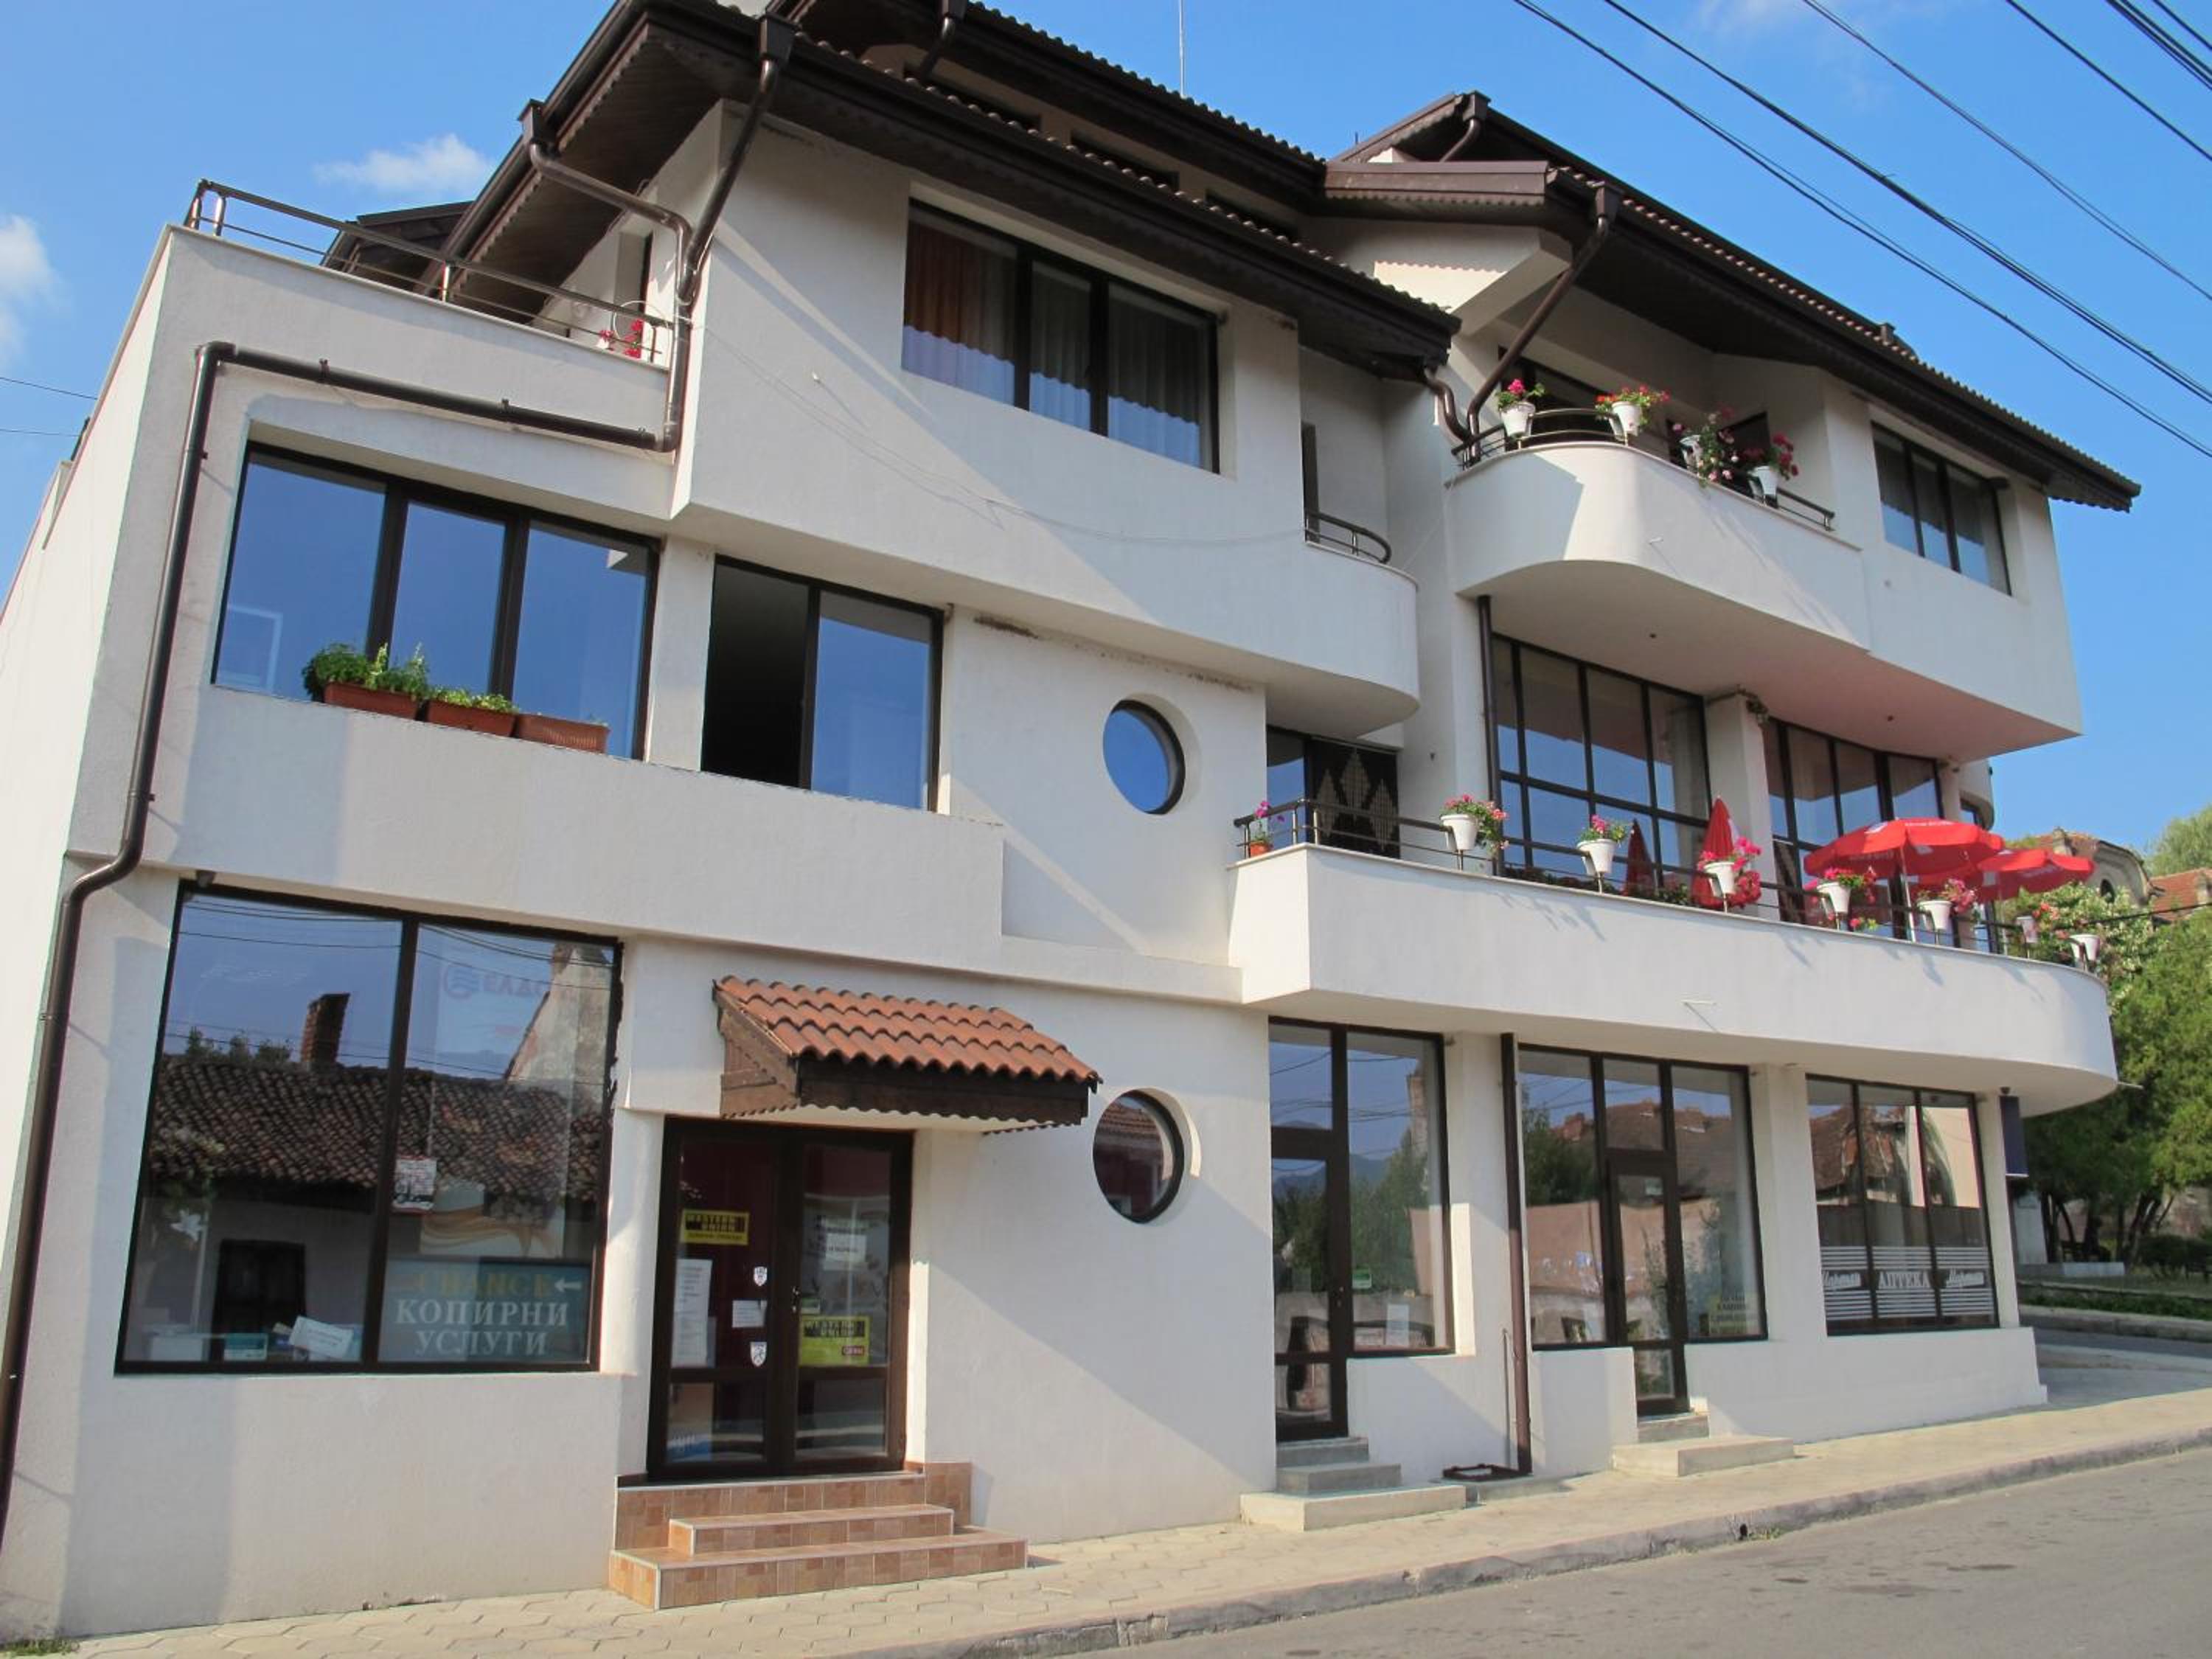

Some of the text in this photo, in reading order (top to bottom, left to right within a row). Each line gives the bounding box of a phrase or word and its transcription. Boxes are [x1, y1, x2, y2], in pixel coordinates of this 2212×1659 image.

[1879, 1271, 1931, 1289] АПТЕКА
[395, 1298, 568, 1326] КОПИРНИ
[415, 1330, 548, 1357] УСЛУГИ
